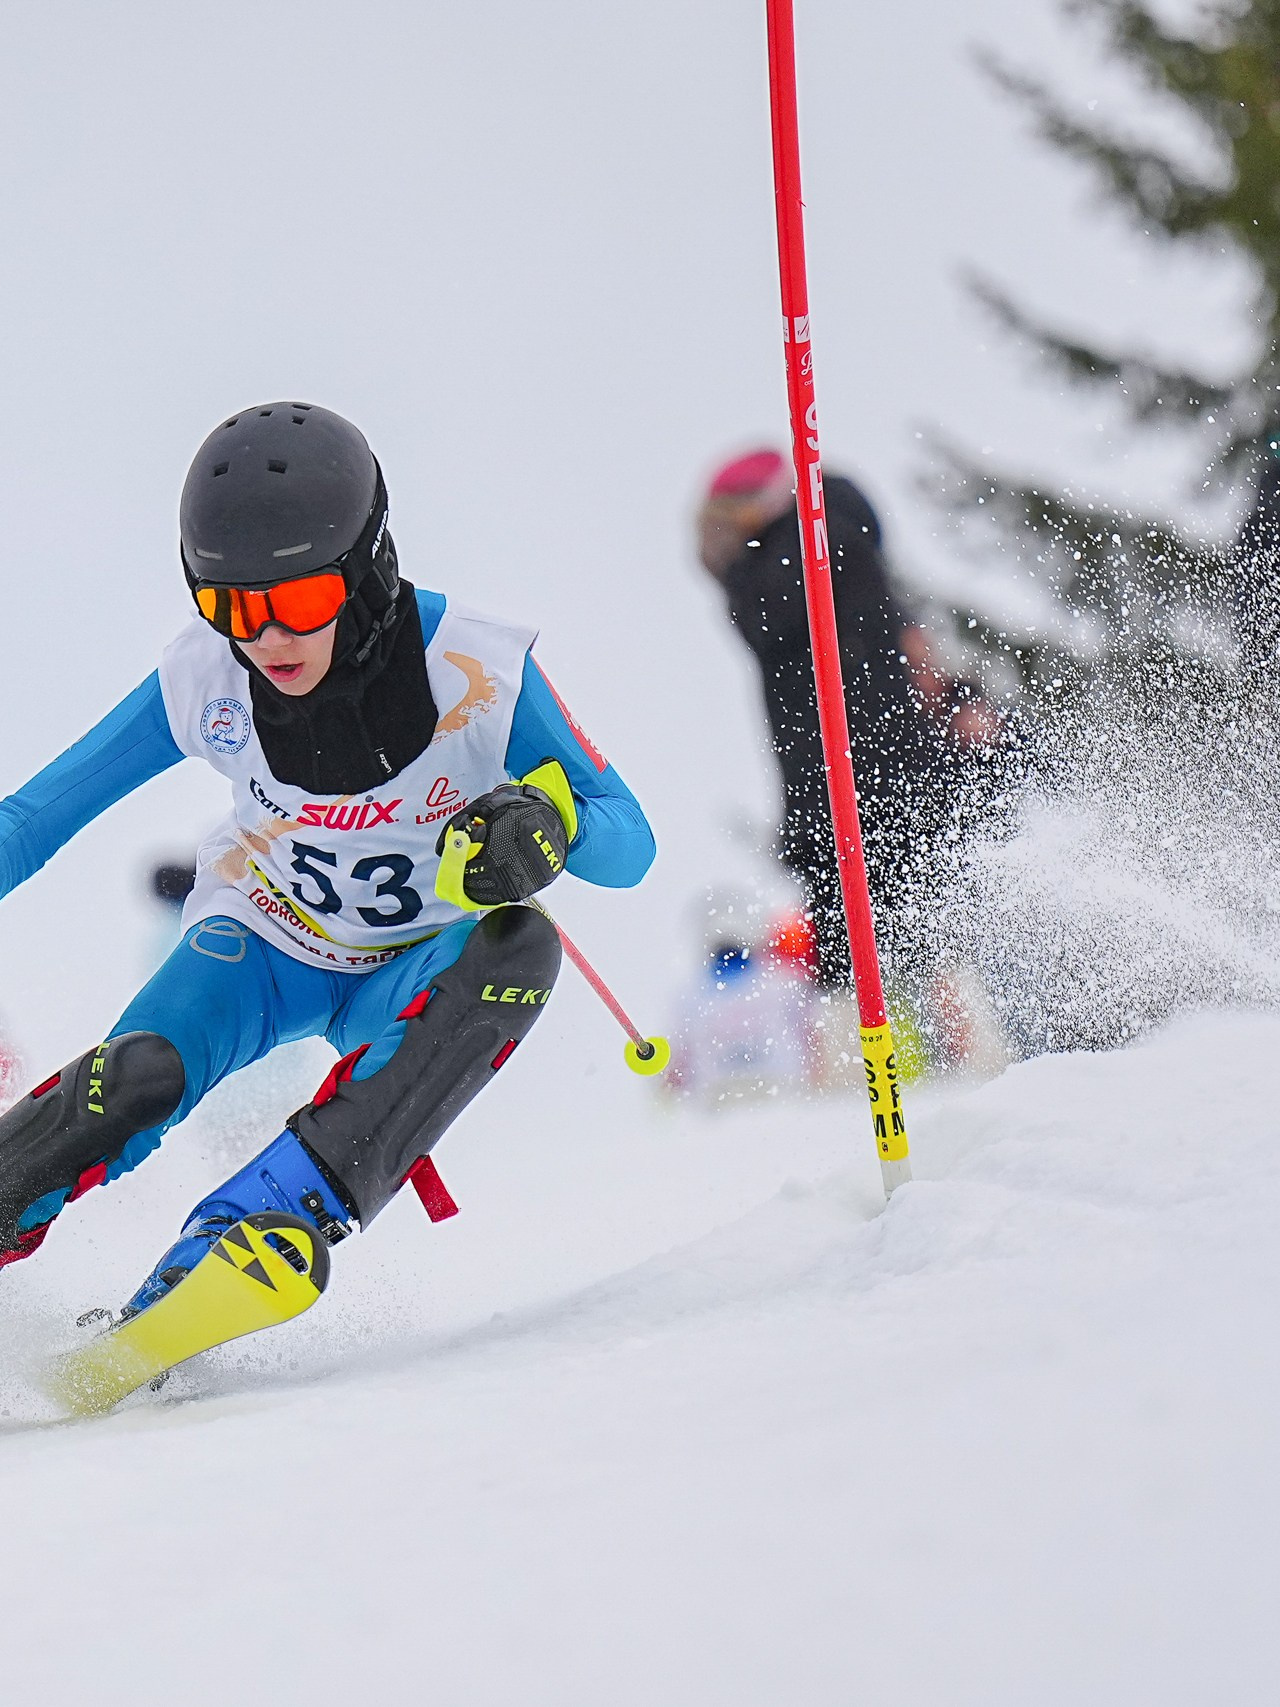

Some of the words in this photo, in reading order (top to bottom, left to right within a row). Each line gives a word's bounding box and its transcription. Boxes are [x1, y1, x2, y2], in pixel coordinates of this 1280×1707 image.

[415, 797, 468, 825] Löffler
[532, 829, 561, 873] LEKI
[289, 838, 423, 927] 53
[481, 984, 552, 1005] LEKI
[87, 1042, 111, 1115] LEKI
